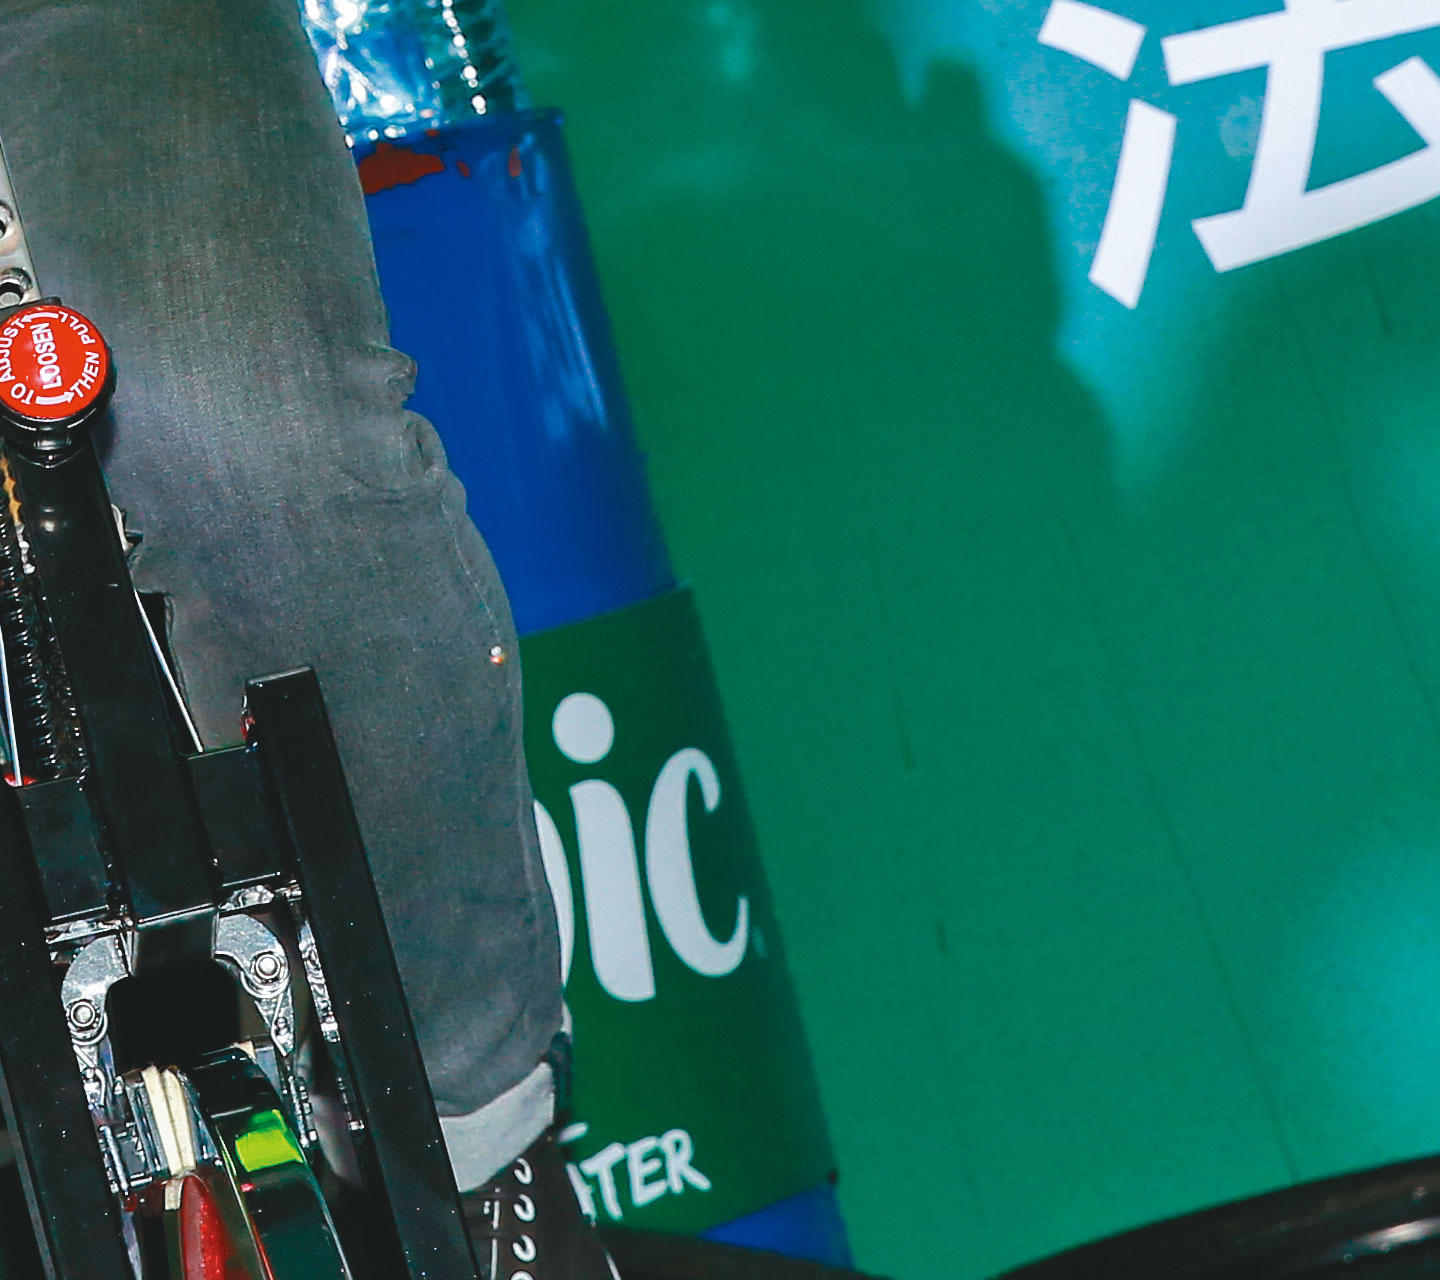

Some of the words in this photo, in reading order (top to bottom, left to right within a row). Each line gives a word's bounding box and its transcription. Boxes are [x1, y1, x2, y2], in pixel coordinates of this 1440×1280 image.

[58, 311, 96, 345] PULL
[30, 322, 62, 390] LOOSEN
[69, 351, 100, 398] THEN
[10, 382, 35, 405] TO
